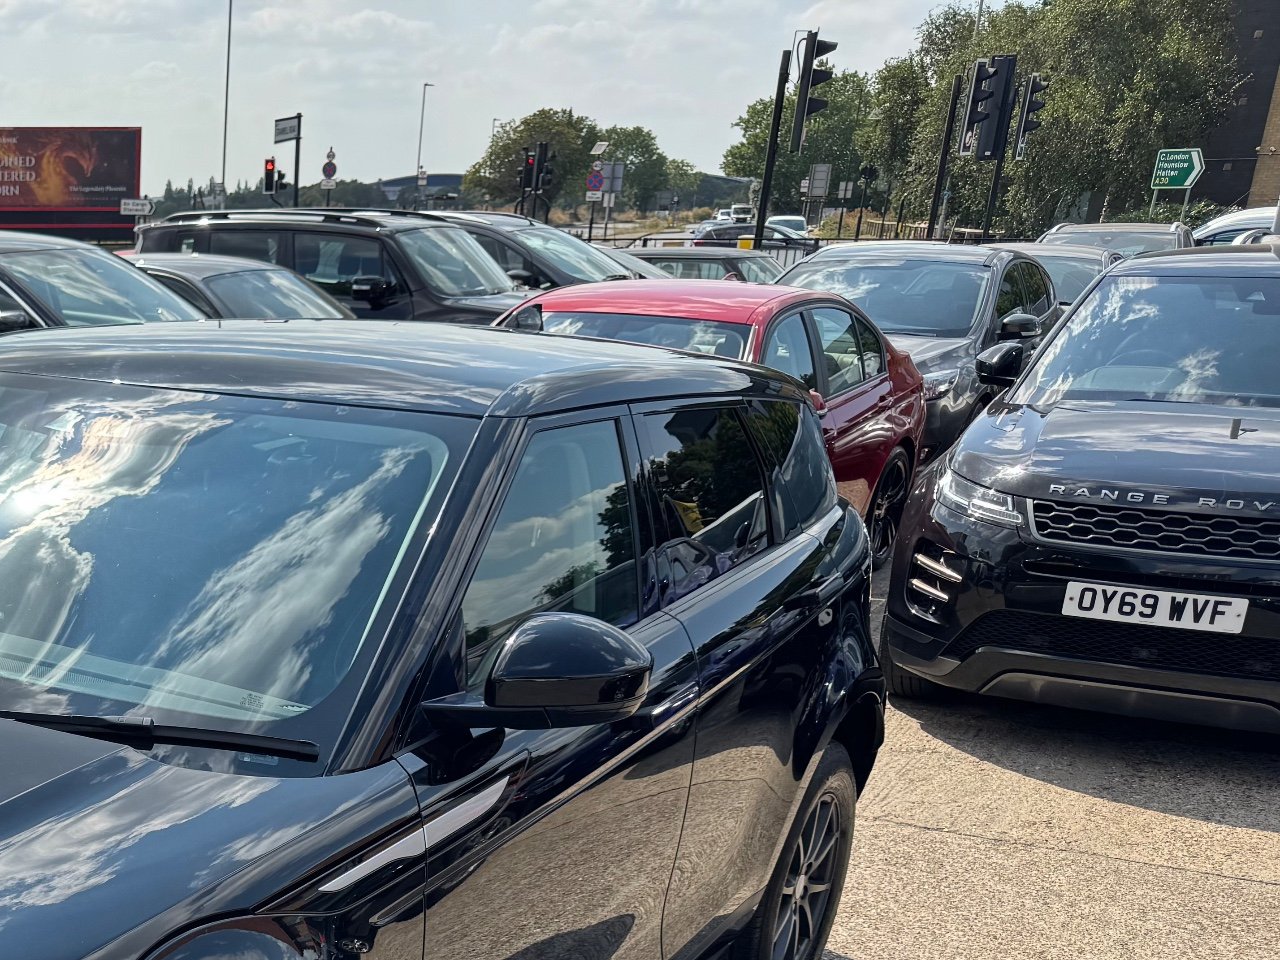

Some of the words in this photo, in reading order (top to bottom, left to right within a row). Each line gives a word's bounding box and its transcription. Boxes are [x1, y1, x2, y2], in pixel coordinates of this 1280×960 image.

[1158, 161, 1189, 169] Hounslow
[1154, 177, 1169, 185] A30
[1049, 484, 1170, 505] RANGE
[1077, 587, 1160, 619] OY69
[1168, 595, 1233, 625] WVF
